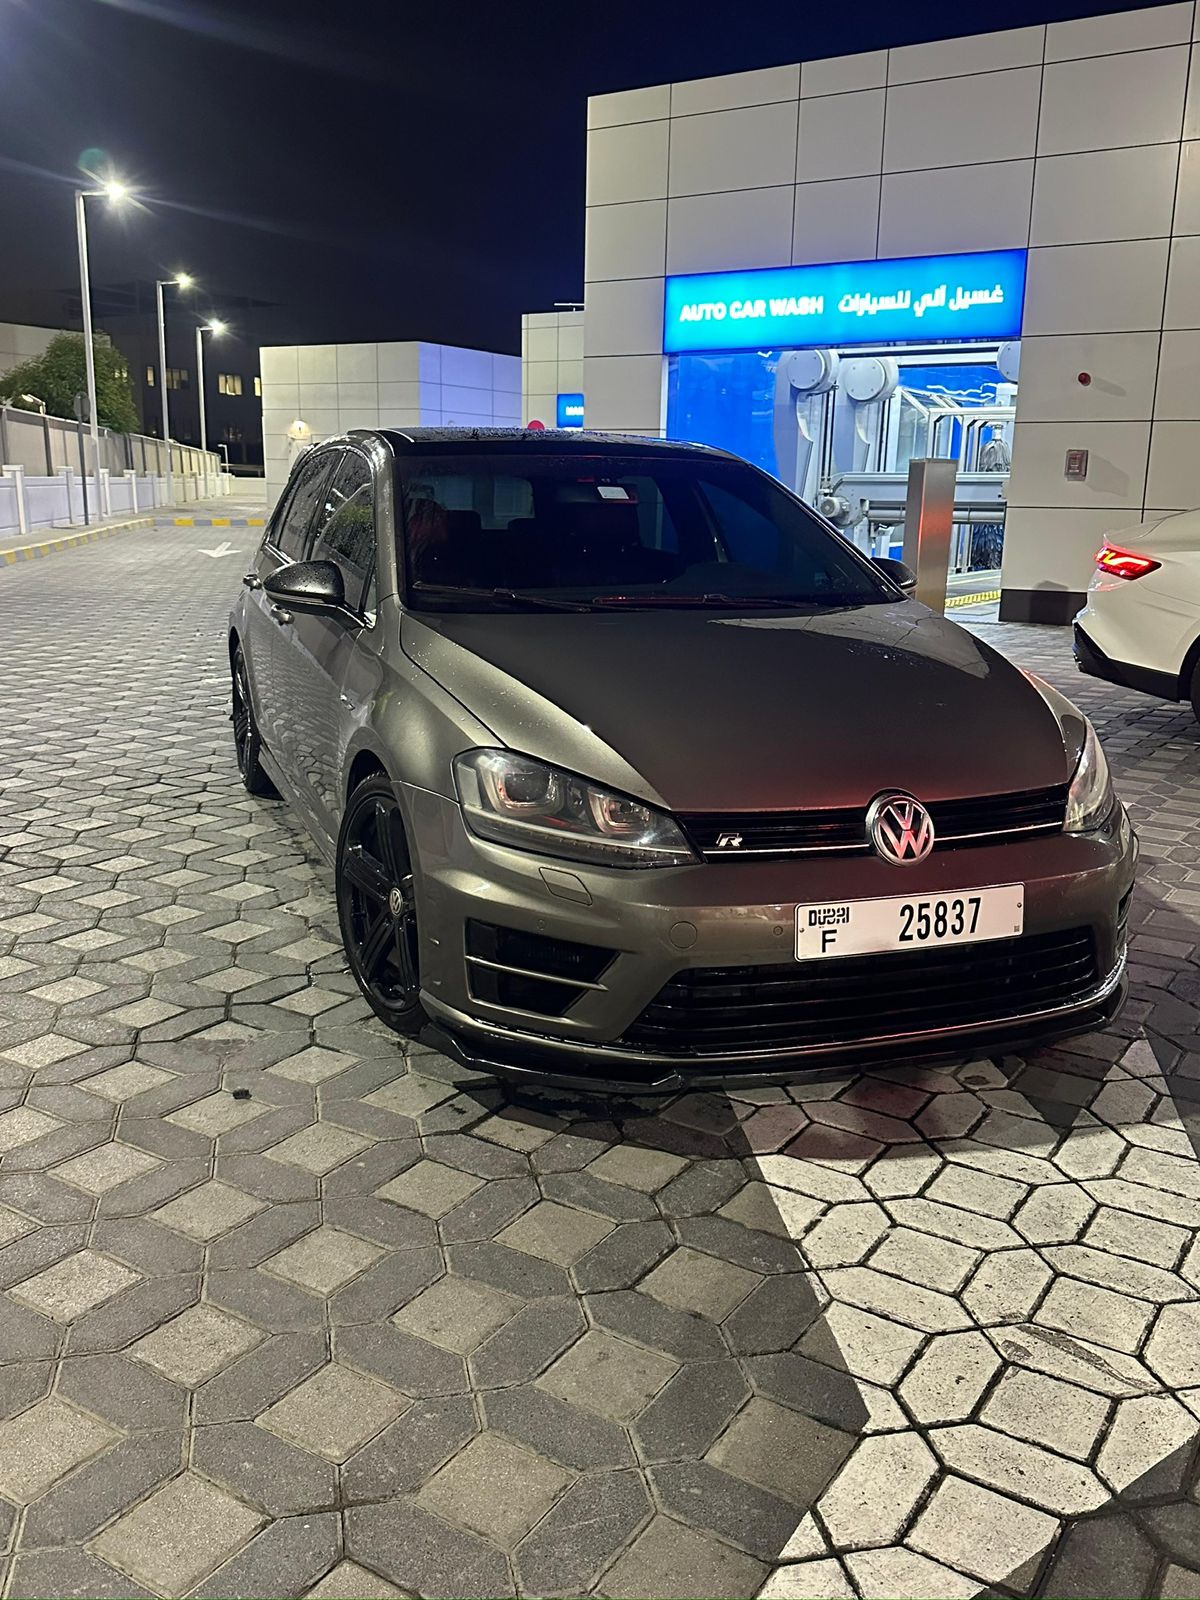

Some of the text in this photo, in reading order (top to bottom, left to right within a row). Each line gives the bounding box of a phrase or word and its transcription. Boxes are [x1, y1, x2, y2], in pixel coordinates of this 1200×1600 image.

[679, 295, 824, 322] AUTO CAR WASH
[837, 290, 911, 317] للسيارات
[949, 284, 1004, 311] غسيل
[716, 832, 743, 848] R
[808, 906, 850, 926] DUBAI
[899, 897, 982, 942] 25837
[821, 929, 838, 953] F
